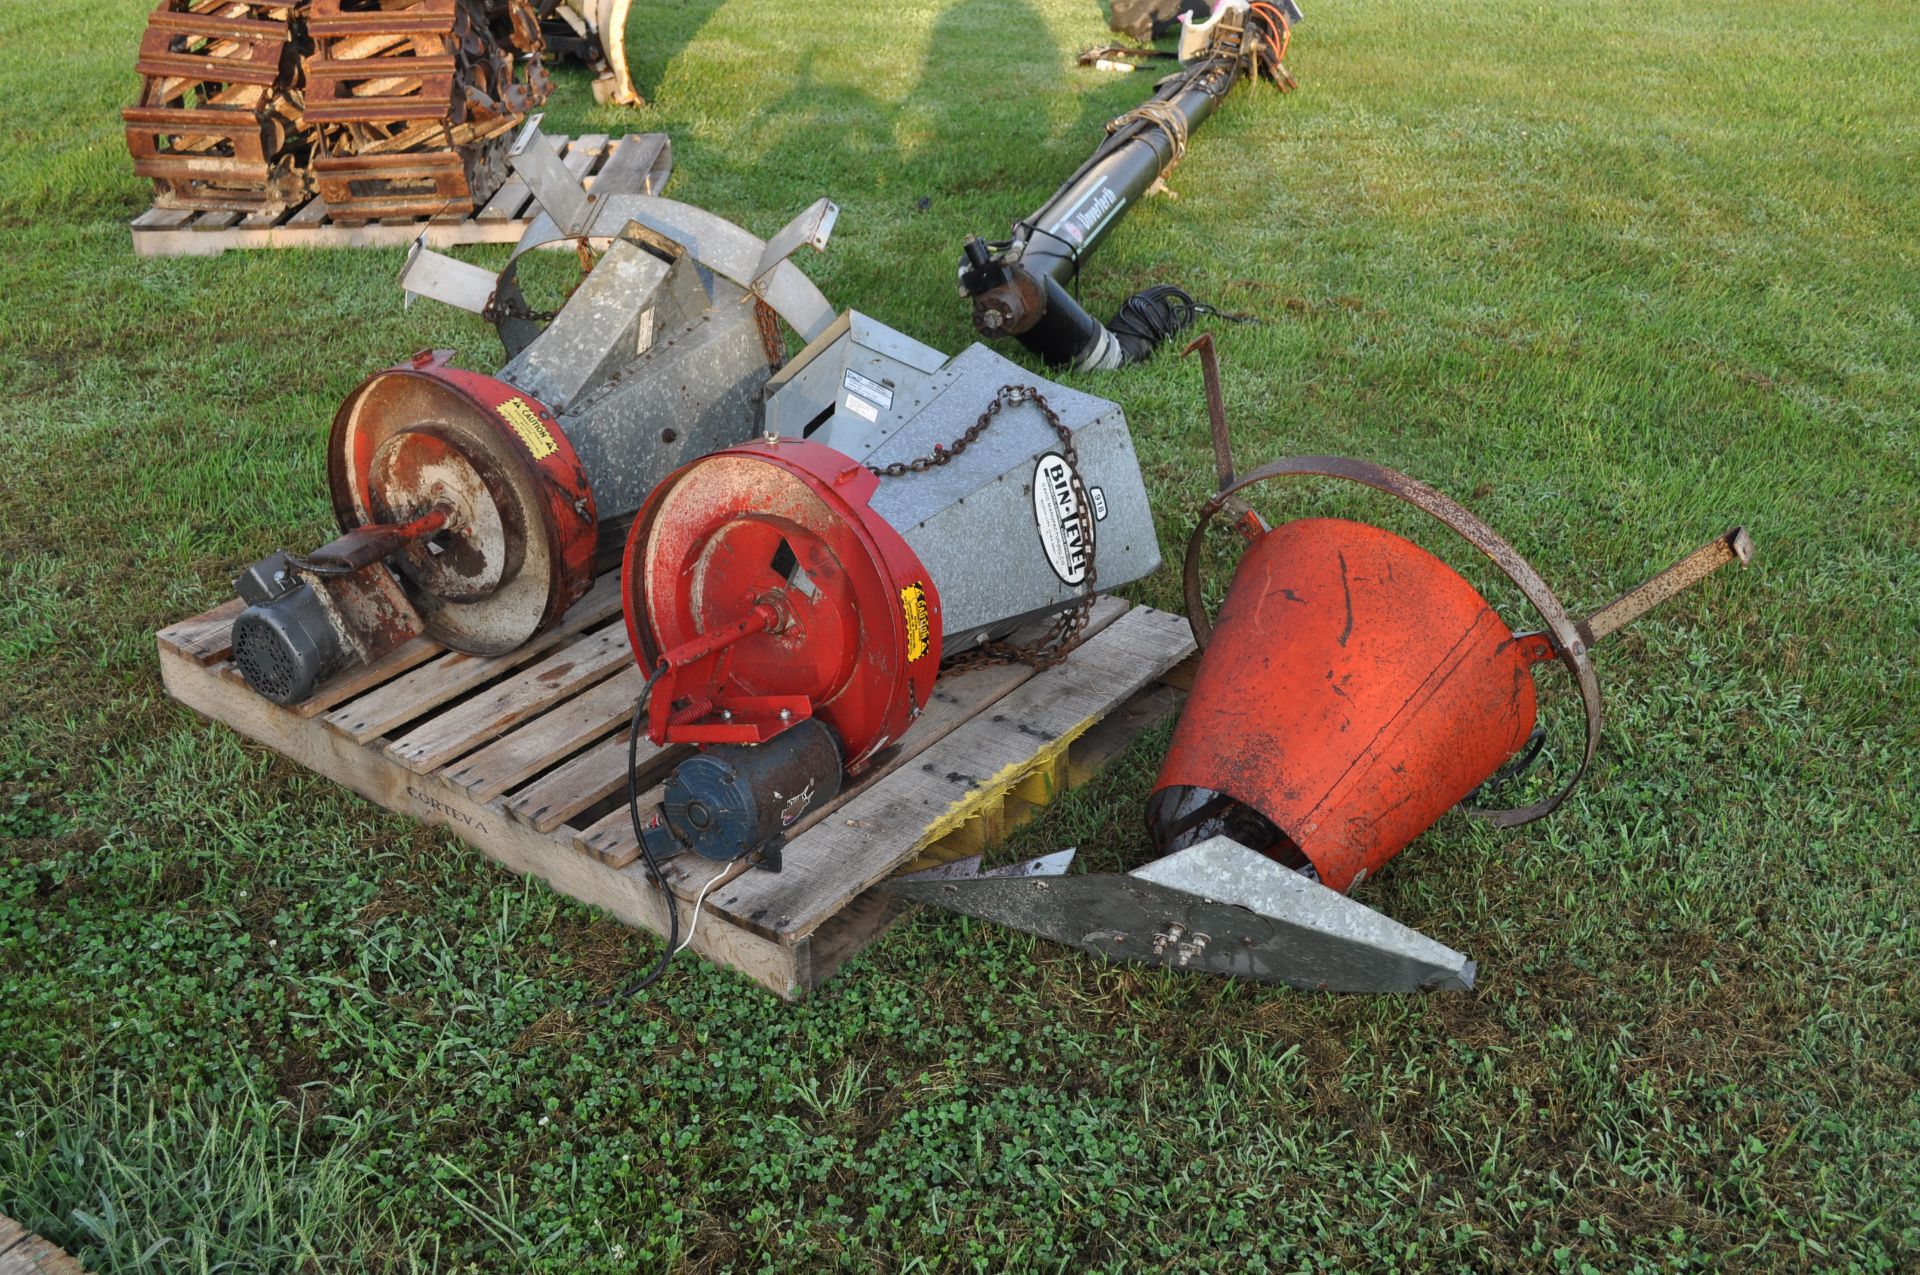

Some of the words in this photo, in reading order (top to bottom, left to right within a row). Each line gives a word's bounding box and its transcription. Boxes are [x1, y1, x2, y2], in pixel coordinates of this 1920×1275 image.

[522, 409, 547, 438] CAUTION
[1094, 493, 1105, 513] 918
[917, 599, 928, 639] CAUTION
[406, 786, 488, 834] CORTEVA
